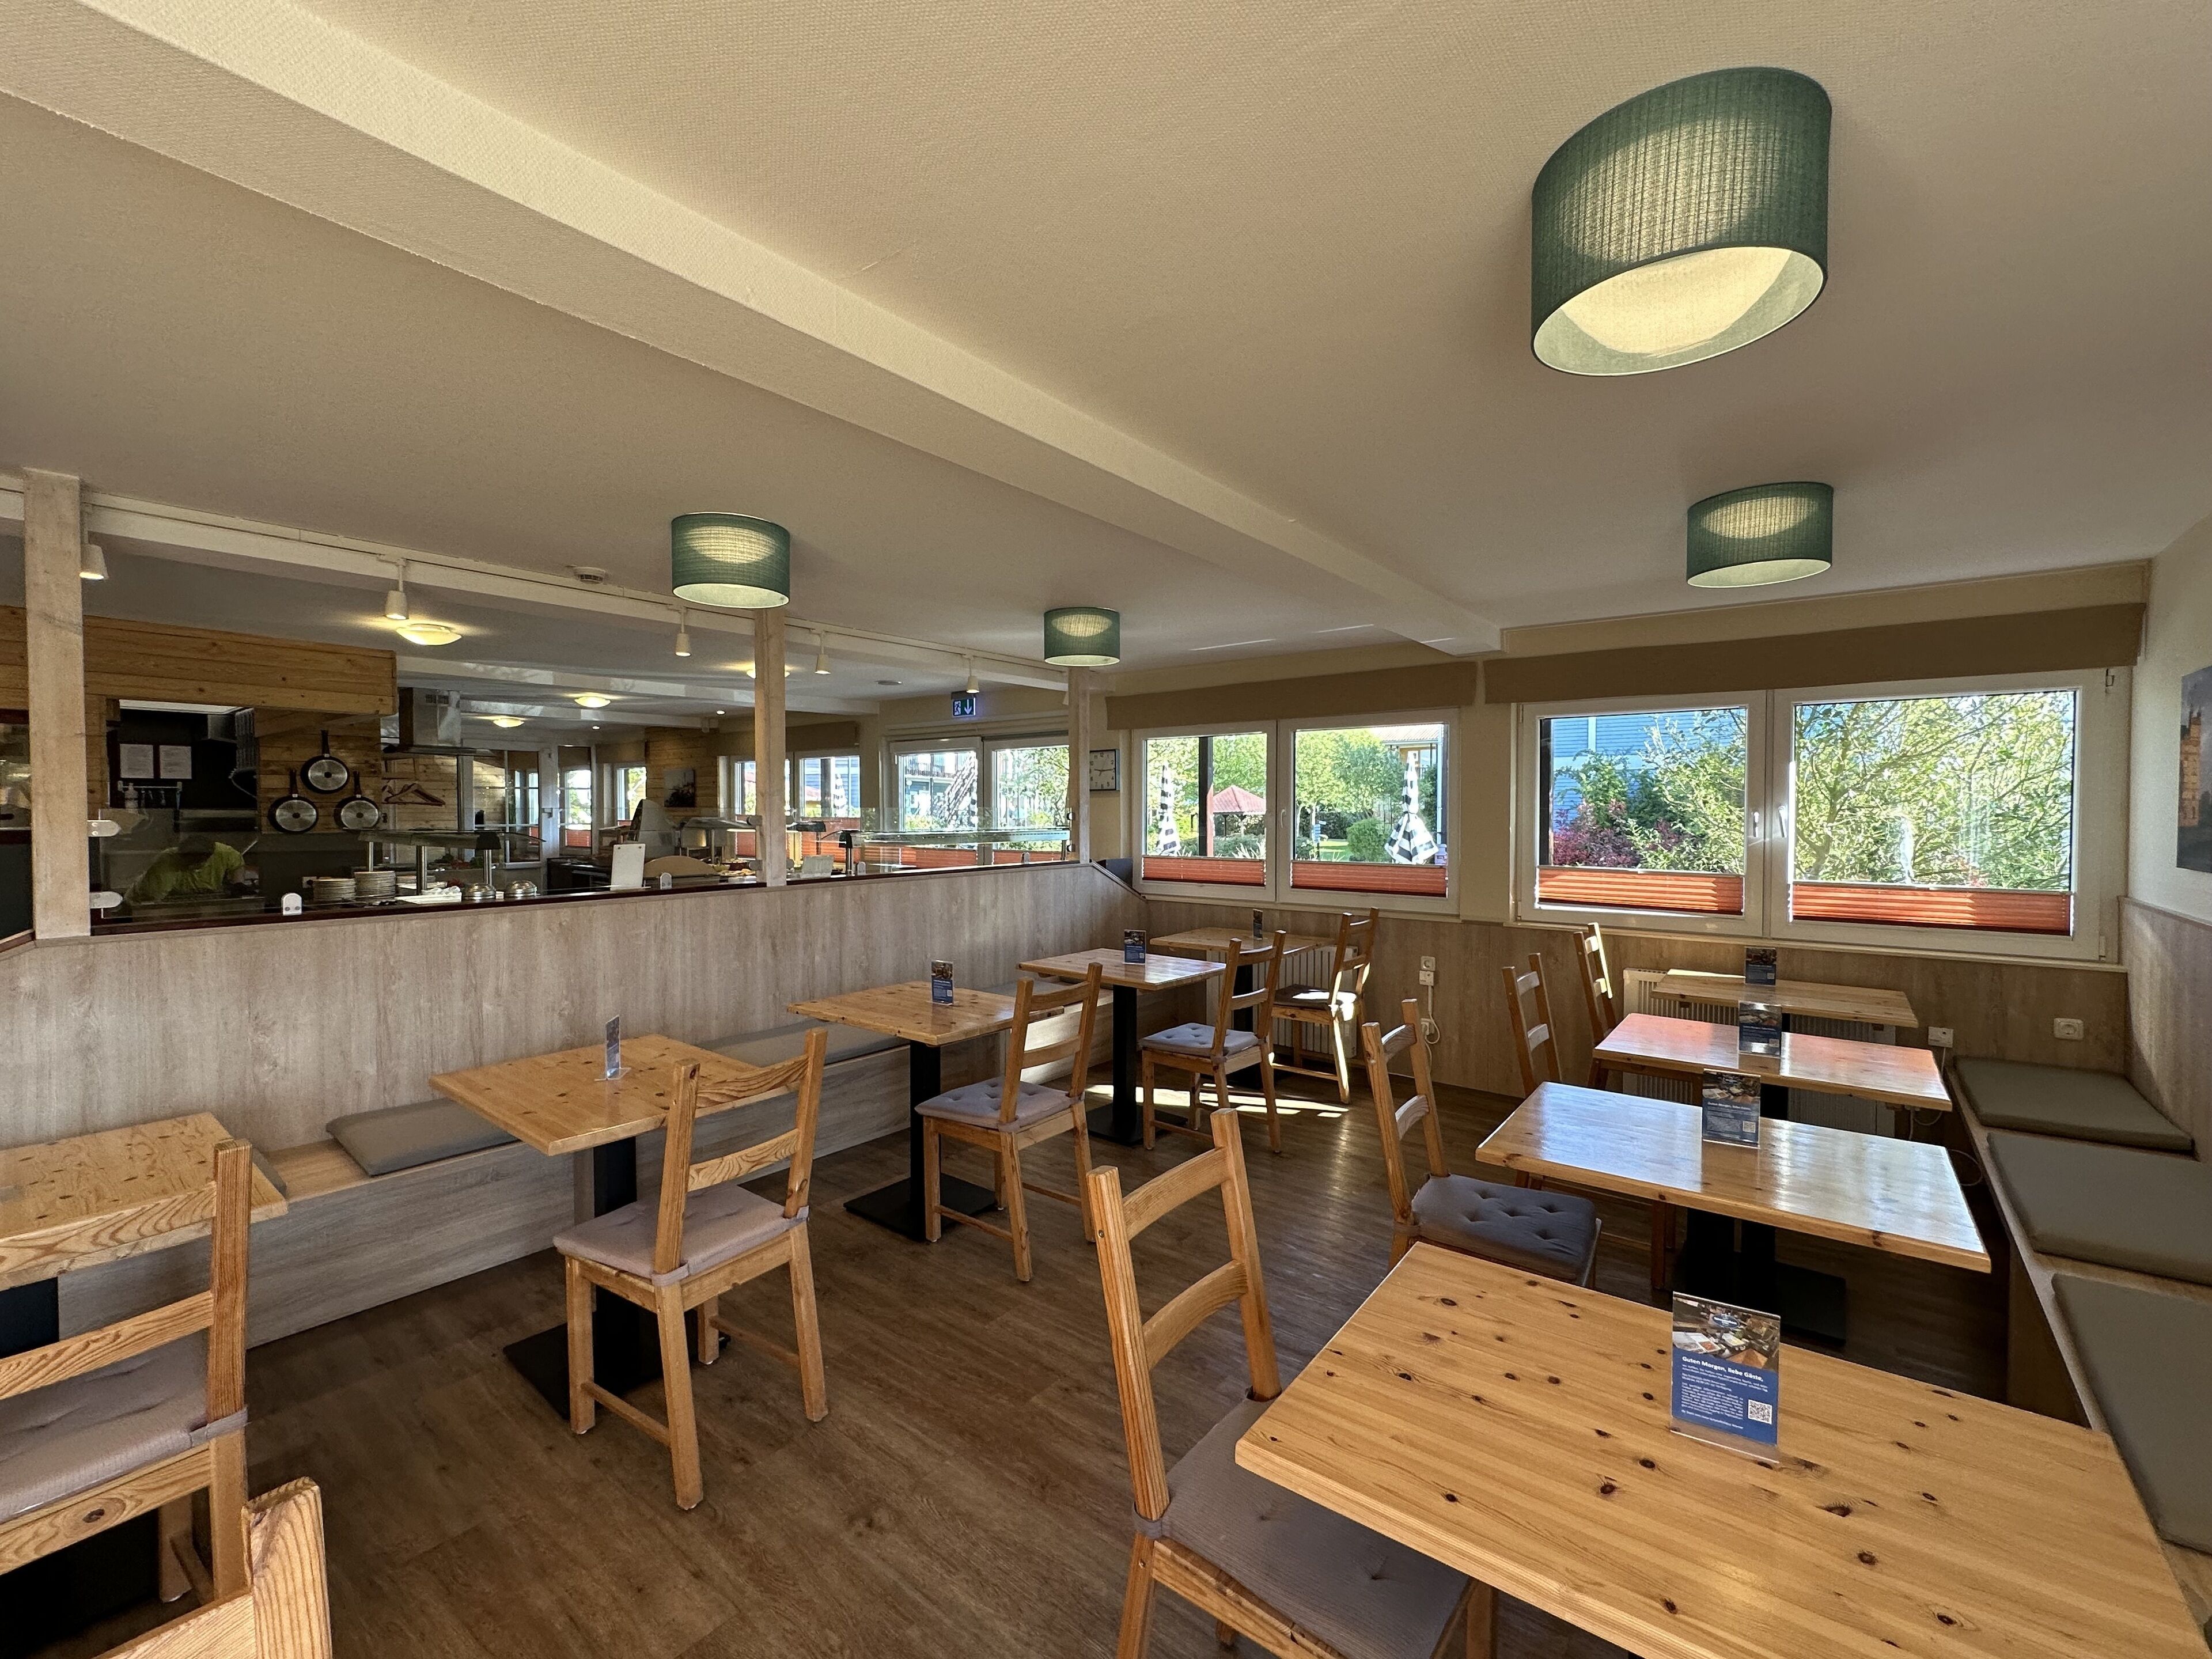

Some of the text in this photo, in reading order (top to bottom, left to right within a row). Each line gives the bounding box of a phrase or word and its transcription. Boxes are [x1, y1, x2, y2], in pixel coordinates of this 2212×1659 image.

[1681, 1356, 1700, 1365] Guten
[1702, 1360, 1727, 1373] Morgen,
[1728, 1366, 1743, 1376] liebe
